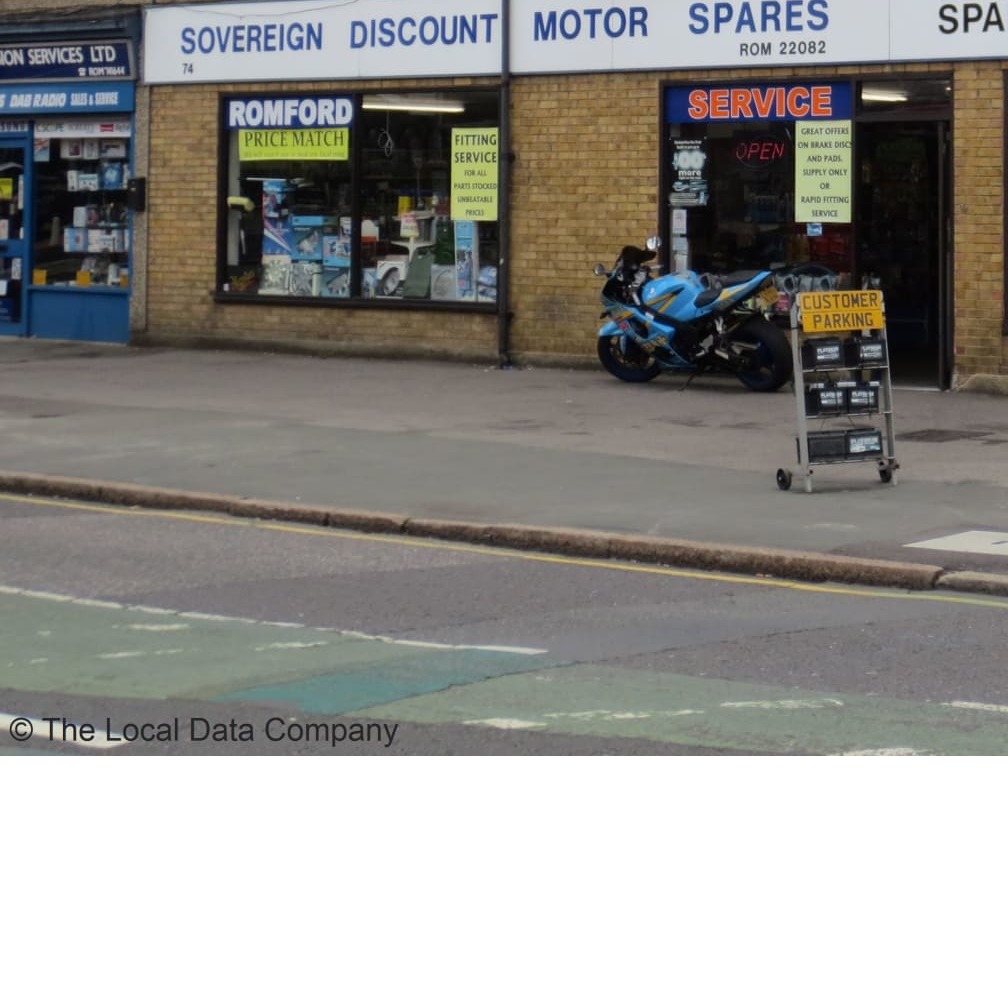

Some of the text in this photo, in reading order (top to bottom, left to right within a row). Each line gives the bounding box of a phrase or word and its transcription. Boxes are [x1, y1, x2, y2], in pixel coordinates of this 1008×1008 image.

[181, 22, 323, 55] SOVEREIGN
[350, 13, 498, 49] DISCOUNT
[533, 6, 648, 42] MOTOR
[28, 47, 84, 65] SERVICES
[90, 45, 116, 62] LTD
[739, 40, 826, 56] ROM 22082
[182, 62, 194, 75] 74
[33, 92, 67, 107] RADIO
[688, 86, 833, 120] SERVICE
[229, 98, 352, 126] ROMFORD
[801, 127, 849, 135] GREAT OFFERS
[244, 130, 344, 147] PRICE MATCH
[455, 134, 496, 146] FITTING
[798, 141, 809, 149] ON
[811, 141, 832, 149] BRAKE
[454, 152, 496, 164] SERVICE
[736, 142, 785, 160] OPEN
[807, 155, 822, 163] AND
[803, 168, 848, 177] SUPPLY ONLY
[819, 182, 830, 190] OR
[801, 196, 849, 204] RAPID FITTING
[811, 209, 838, 217] SERVICE
[802, 292, 878, 310] CUSTOMER
[813, 311, 874, 328] PARKING
